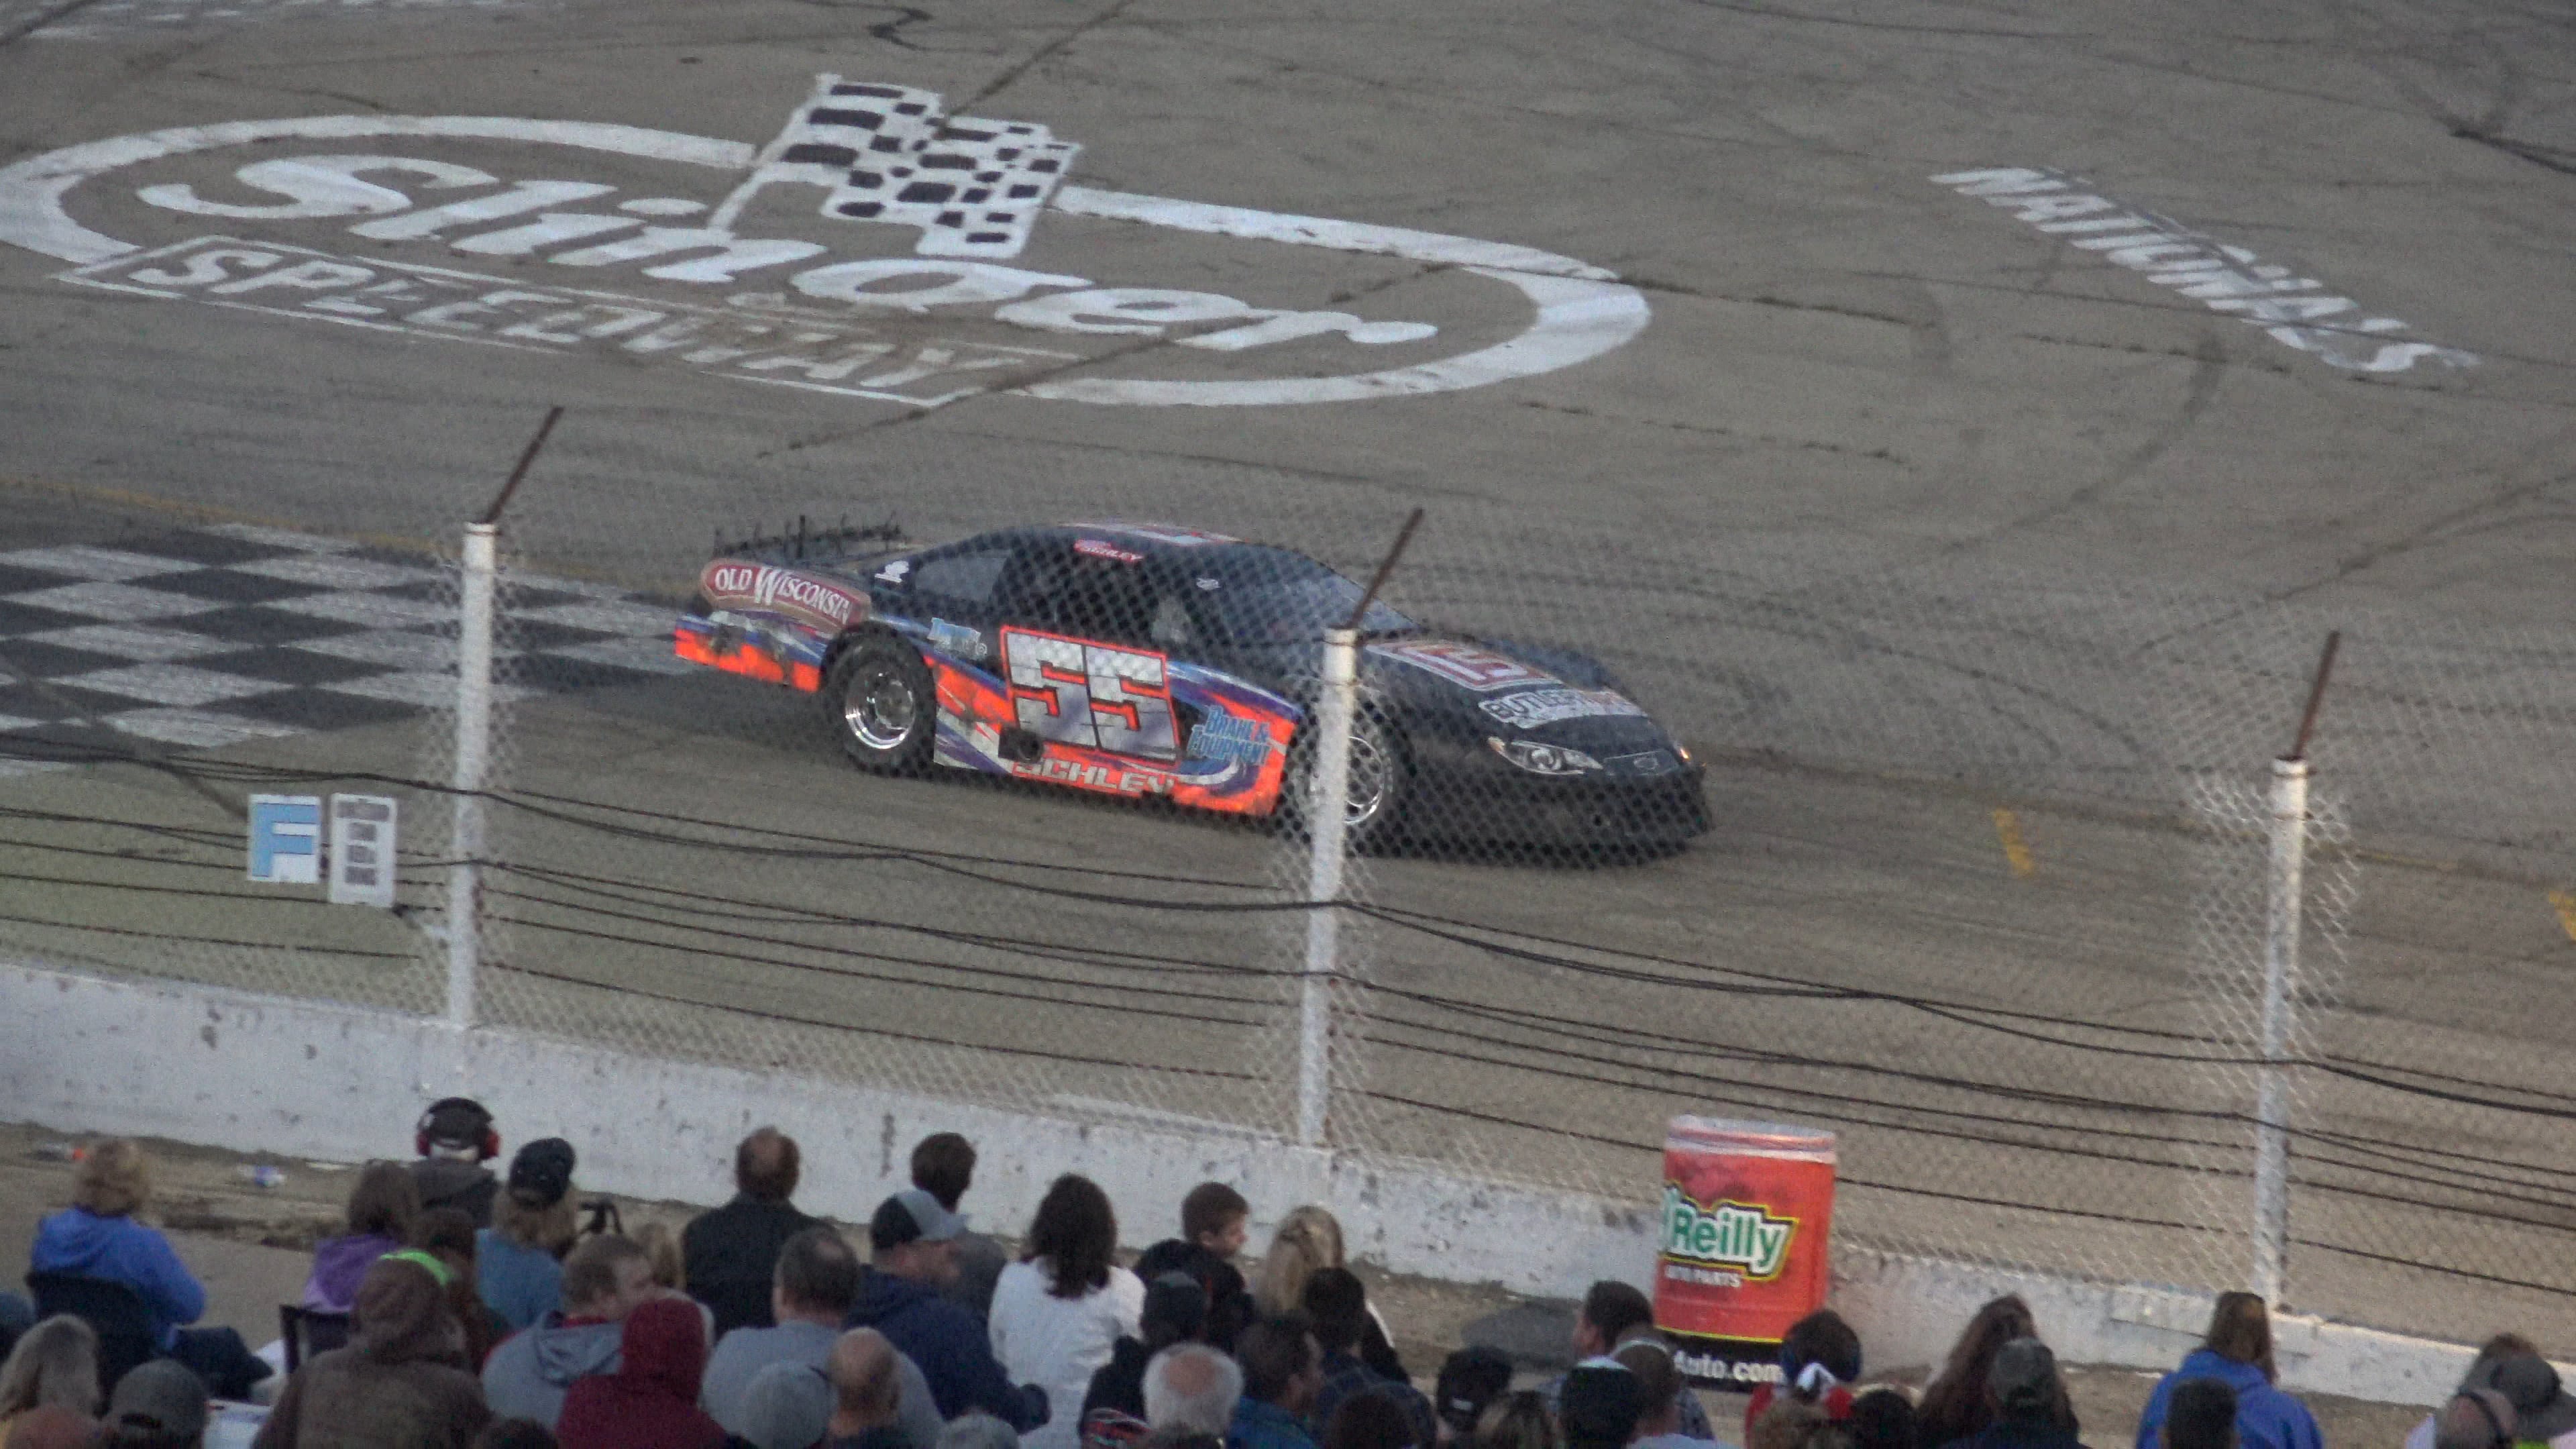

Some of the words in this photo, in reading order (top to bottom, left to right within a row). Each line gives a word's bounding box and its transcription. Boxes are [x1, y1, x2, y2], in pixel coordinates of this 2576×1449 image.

[127, 248, 1025, 388] SPEEDWAY
[137, 154, 1439, 350] Slinger
[714, 568, 753, 591] OLD
[754, 566, 853, 625] WISCONSIN
[1006, 632, 1178, 762] 55
